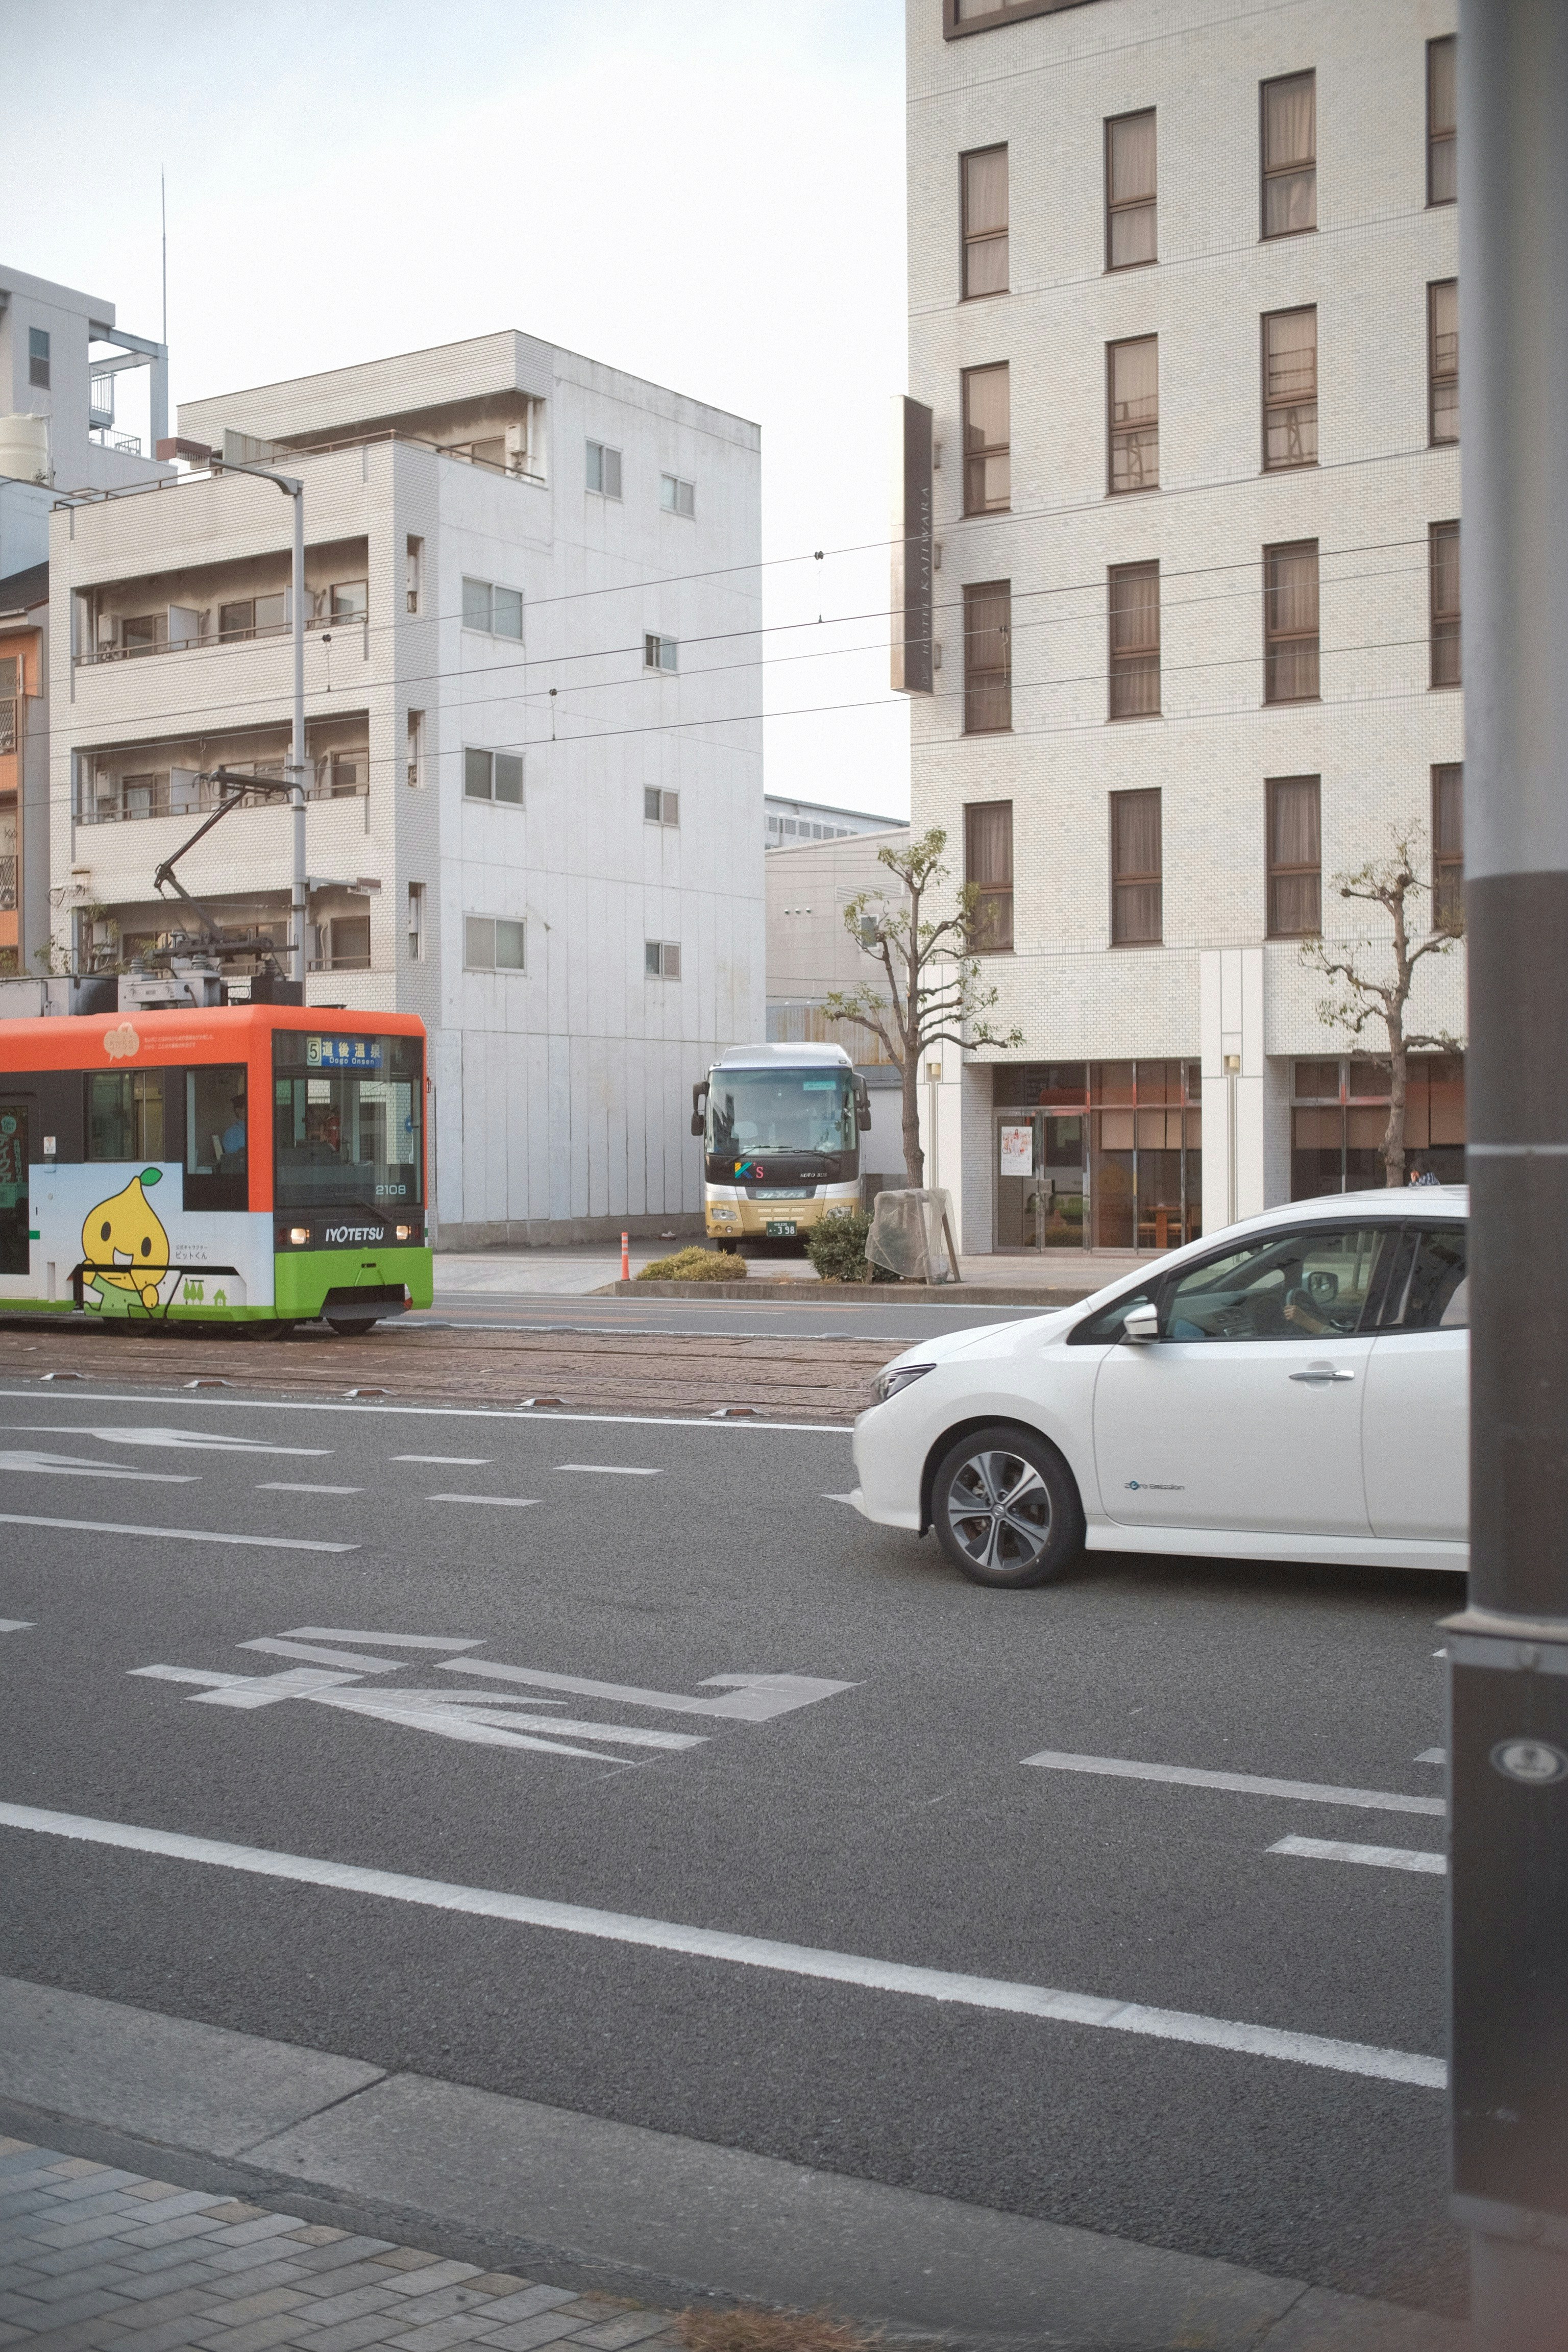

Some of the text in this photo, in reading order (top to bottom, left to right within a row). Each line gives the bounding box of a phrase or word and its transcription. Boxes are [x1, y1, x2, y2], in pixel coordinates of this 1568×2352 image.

[921, 488, 929, 591] KAJIWARA
[309, 1043, 317, 1060] 5
[322, 1041, 381, 1059] 道後温泉
[329, 1057, 348, 1065] Dogo
[376, 1185, 406, 1195] 2108
[325, 1226, 384, 1243] IYOTETSU
